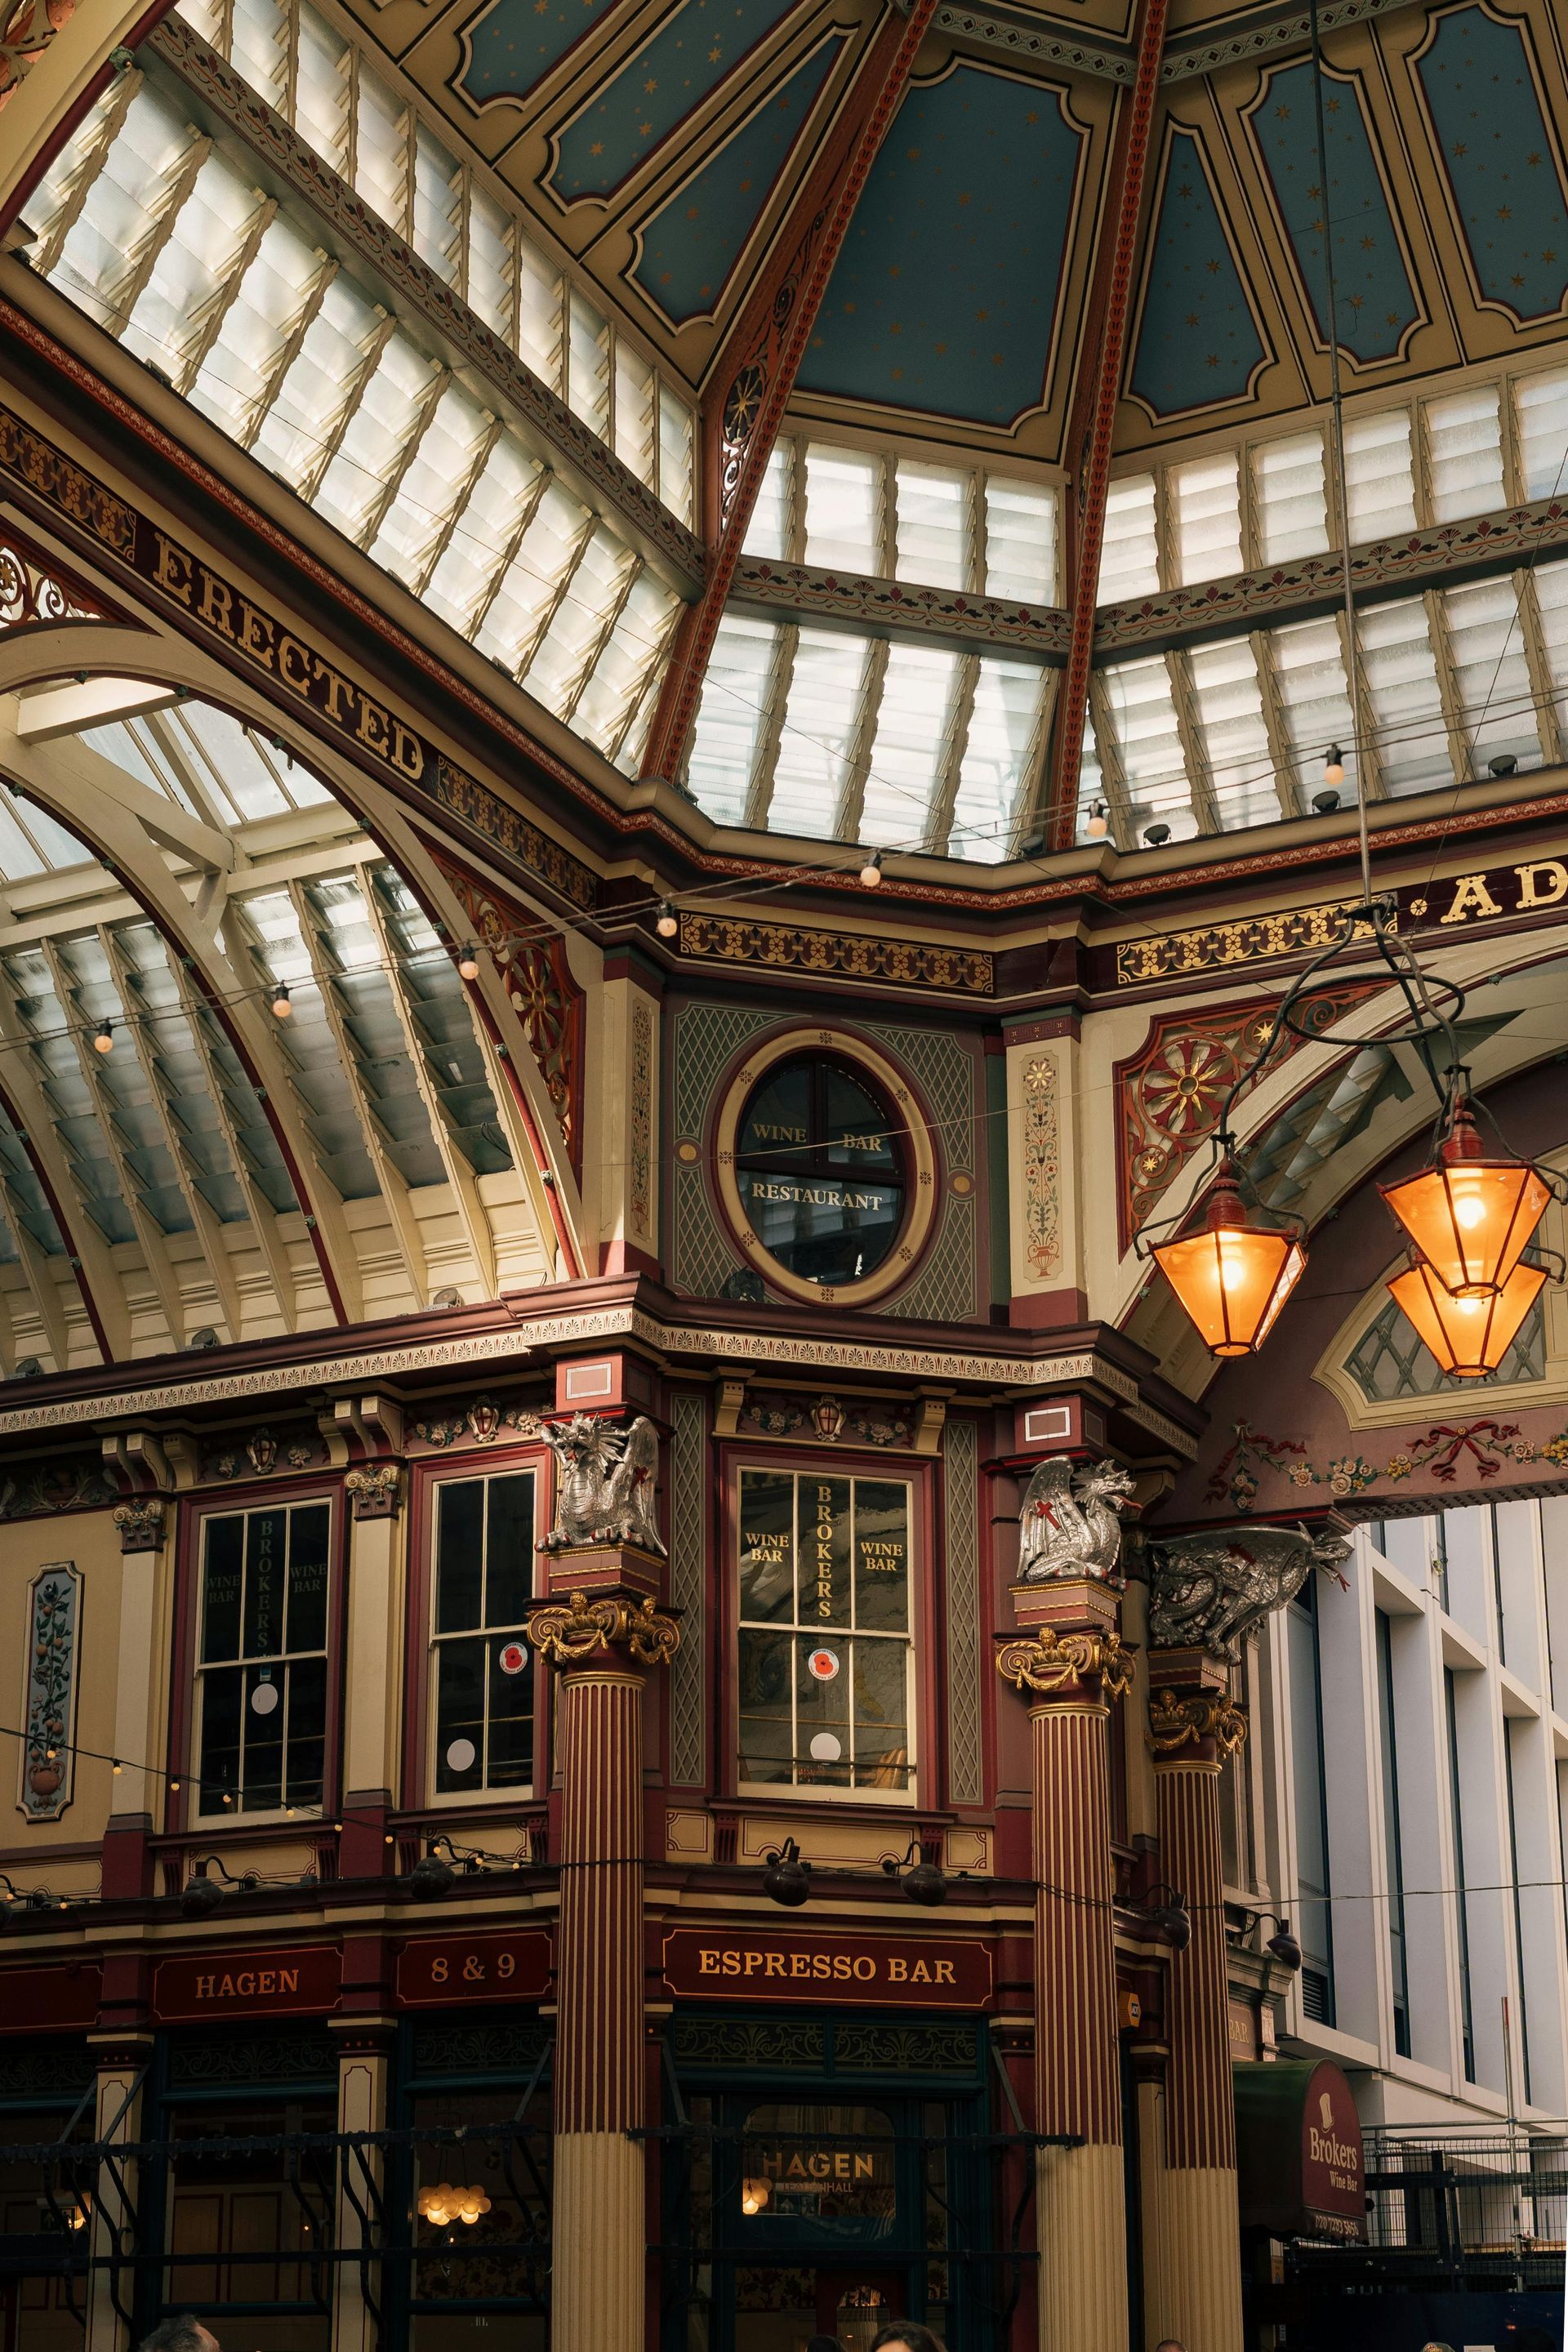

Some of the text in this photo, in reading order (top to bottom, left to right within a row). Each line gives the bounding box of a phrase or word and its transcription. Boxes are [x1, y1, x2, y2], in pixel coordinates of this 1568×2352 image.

[153, 532, 425, 781] ERECTED
[752, 1123, 882, 1152] WINE BAR
[752, 1182, 882, 1211] RESTAURANT
[745, 1532, 790, 1548] WINE
[817, 1486, 833, 1618] BROKERS
[860, 1541, 903, 1557] WINE
[751, 1548, 783, 1562] BAR
[865, 1557, 897, 1571] BAR
[206, 1575, 242, 1589] WINE
[290, 1563, 327, 1579] WINE
[208, 1590, 235, 1604] BAR
[256, 1521, 274, 1648] BROKERS
[293, 1579, 321, 1593] BAR
[431, 1953, 516, 1983] 8 & 9
[698, 1949, 957, 1984] ESPRESSO BAR
[195, 1969, 300, 1998] HAGEN
[1228, 2019, 1250, 2045] BAR
[1309, 2127, 1358, 2171] Brokers
[763, 2152, 874, 2178] HAGEN
[1330, 2170, 1358, 2192] Wine Bar
